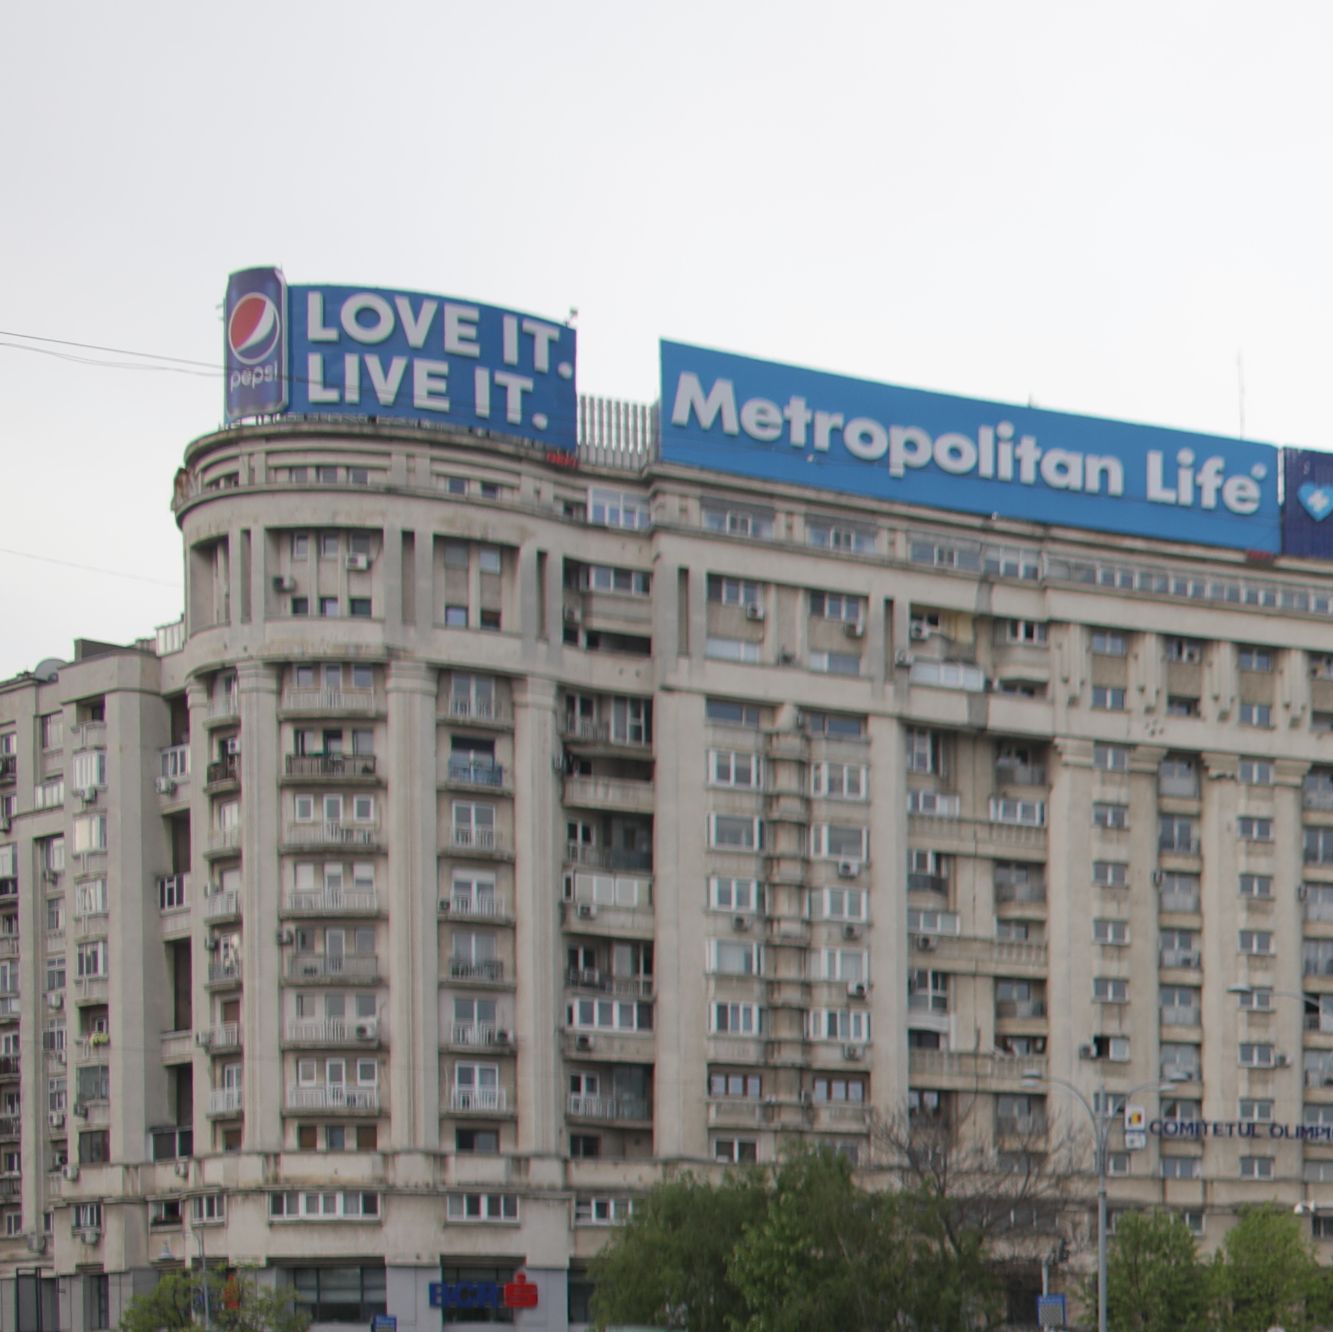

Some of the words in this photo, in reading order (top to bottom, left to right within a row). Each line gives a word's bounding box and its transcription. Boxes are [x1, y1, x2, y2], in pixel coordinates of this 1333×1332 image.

[306, 292, 480, 359] LOVE
[502, 315, 574, 379] IT.
[230, 360, 278, 390] pepsi
[306, 352, 451, 413] LIVE
[474, 368, 548, 430] IT.
[671, 372, 1124, 497] Metropolitan
[1147, 449, 1262, 515] Life
[1150, 1119, 1263, 1138] COMITETUL
[430, 1282, 499, 1309] BCR
